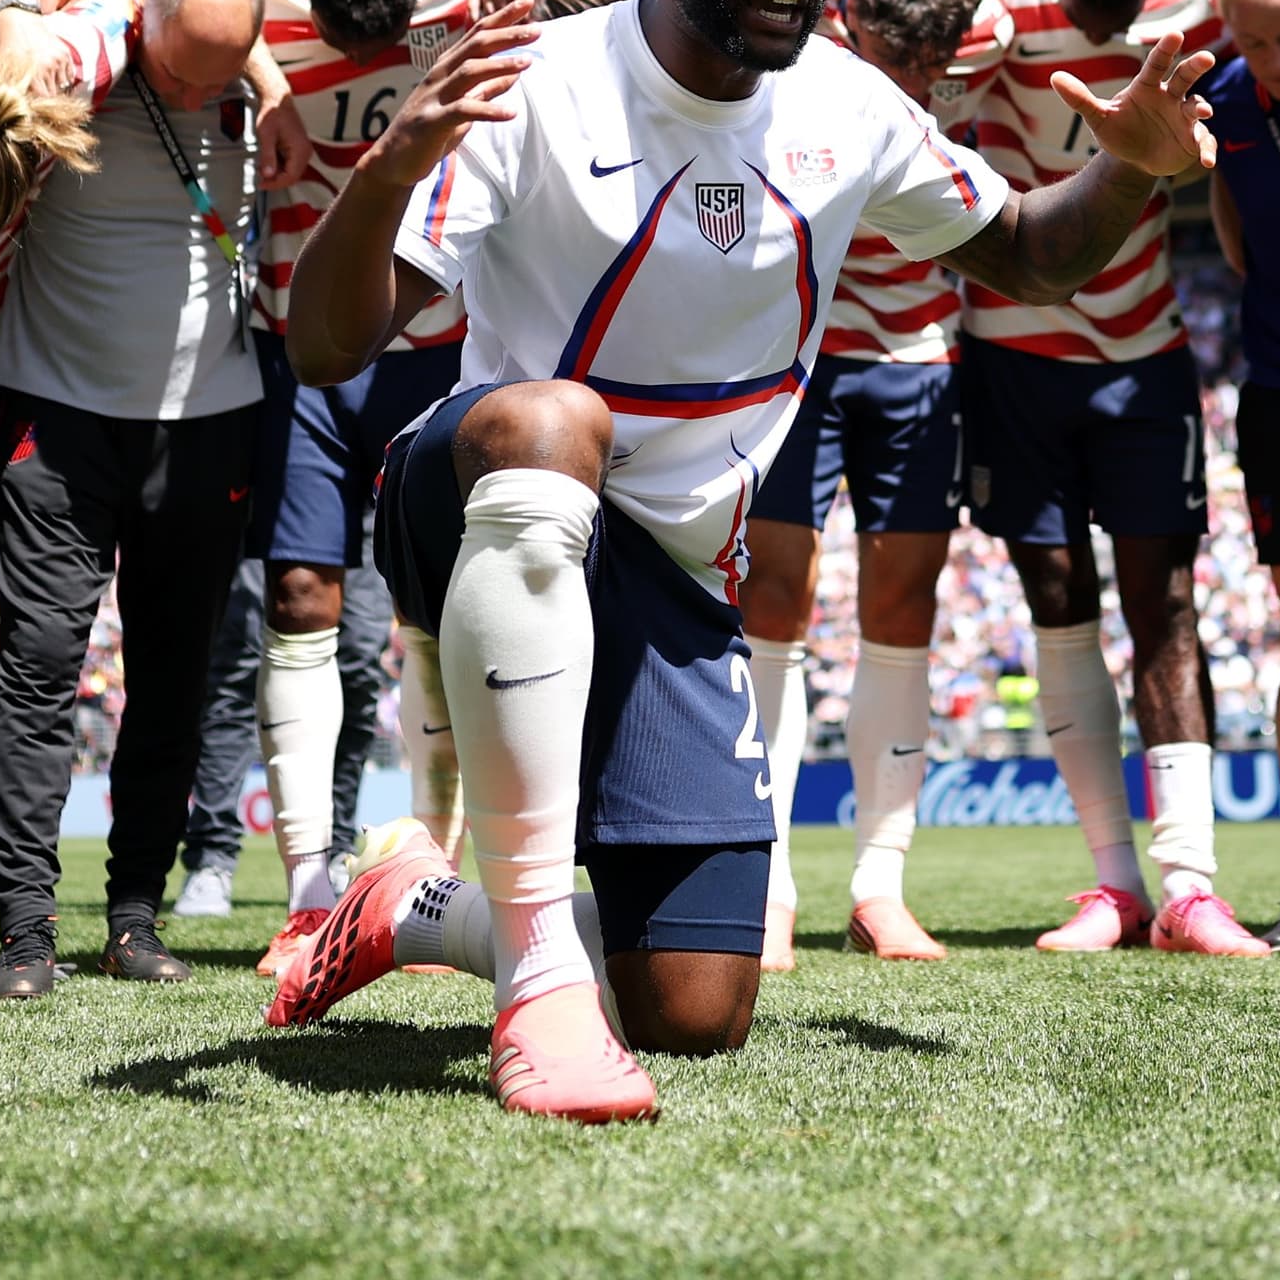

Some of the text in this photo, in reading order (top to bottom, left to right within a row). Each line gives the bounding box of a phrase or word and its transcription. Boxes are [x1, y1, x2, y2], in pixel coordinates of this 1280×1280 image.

[410, 26, 445, 49] USA
[333, 87, 397, 142] 16
[789, 172, 838, 188] SOCCER
[700, 188, 740, 214] USA
[730, 654, 764, 759] 2
